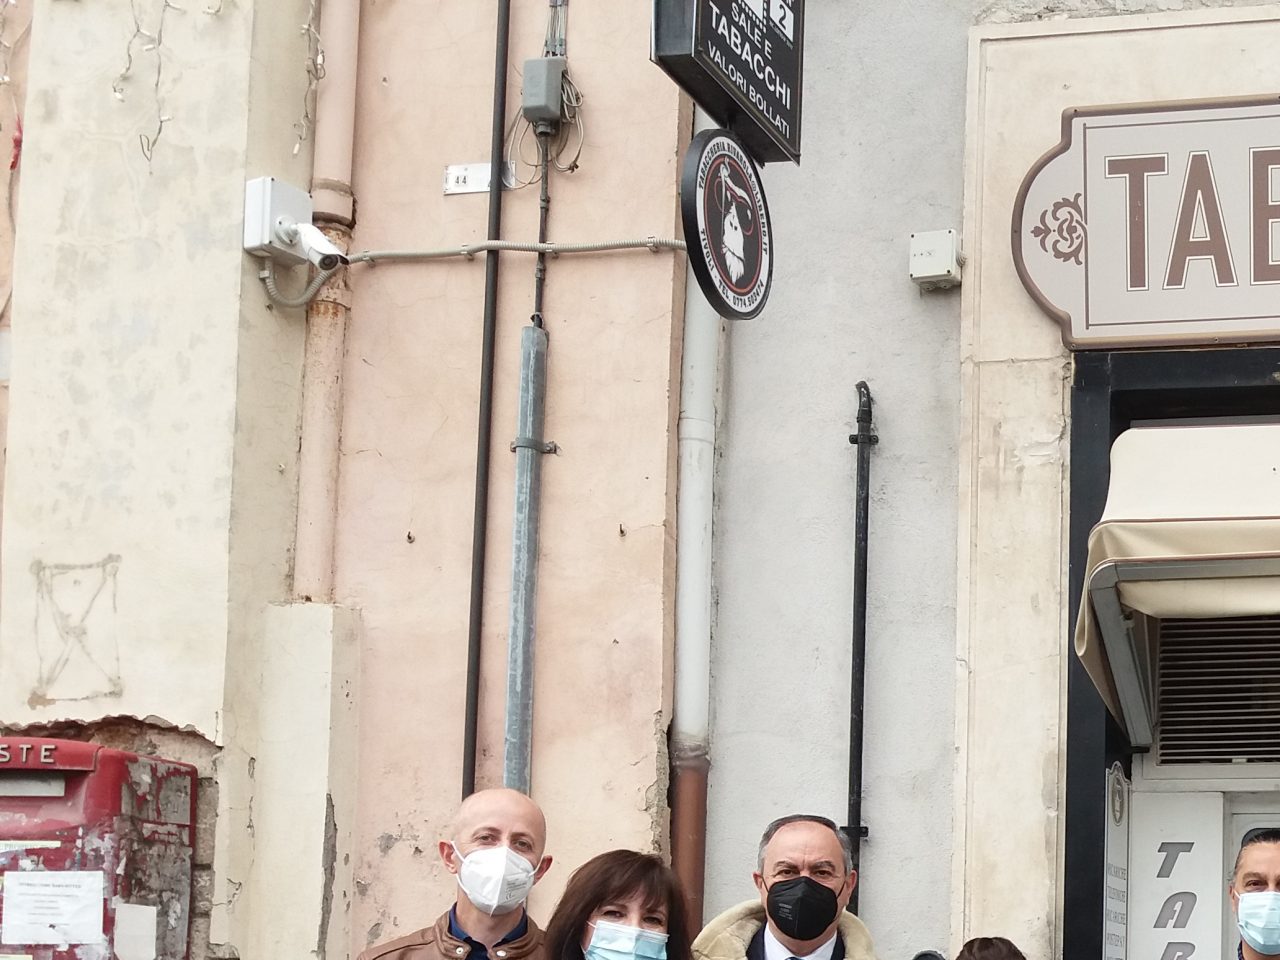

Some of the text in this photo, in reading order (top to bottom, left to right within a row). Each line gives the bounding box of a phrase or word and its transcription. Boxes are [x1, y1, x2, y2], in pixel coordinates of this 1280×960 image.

[708, 0, 791, 111] TABACCHI
[731, 2, 772, 60] SALE E
[708, 40, 747, 93] VALORI
[748, 84, 790, 139] BOLLATI
[701, 228, 715, 272] TIVOLI
